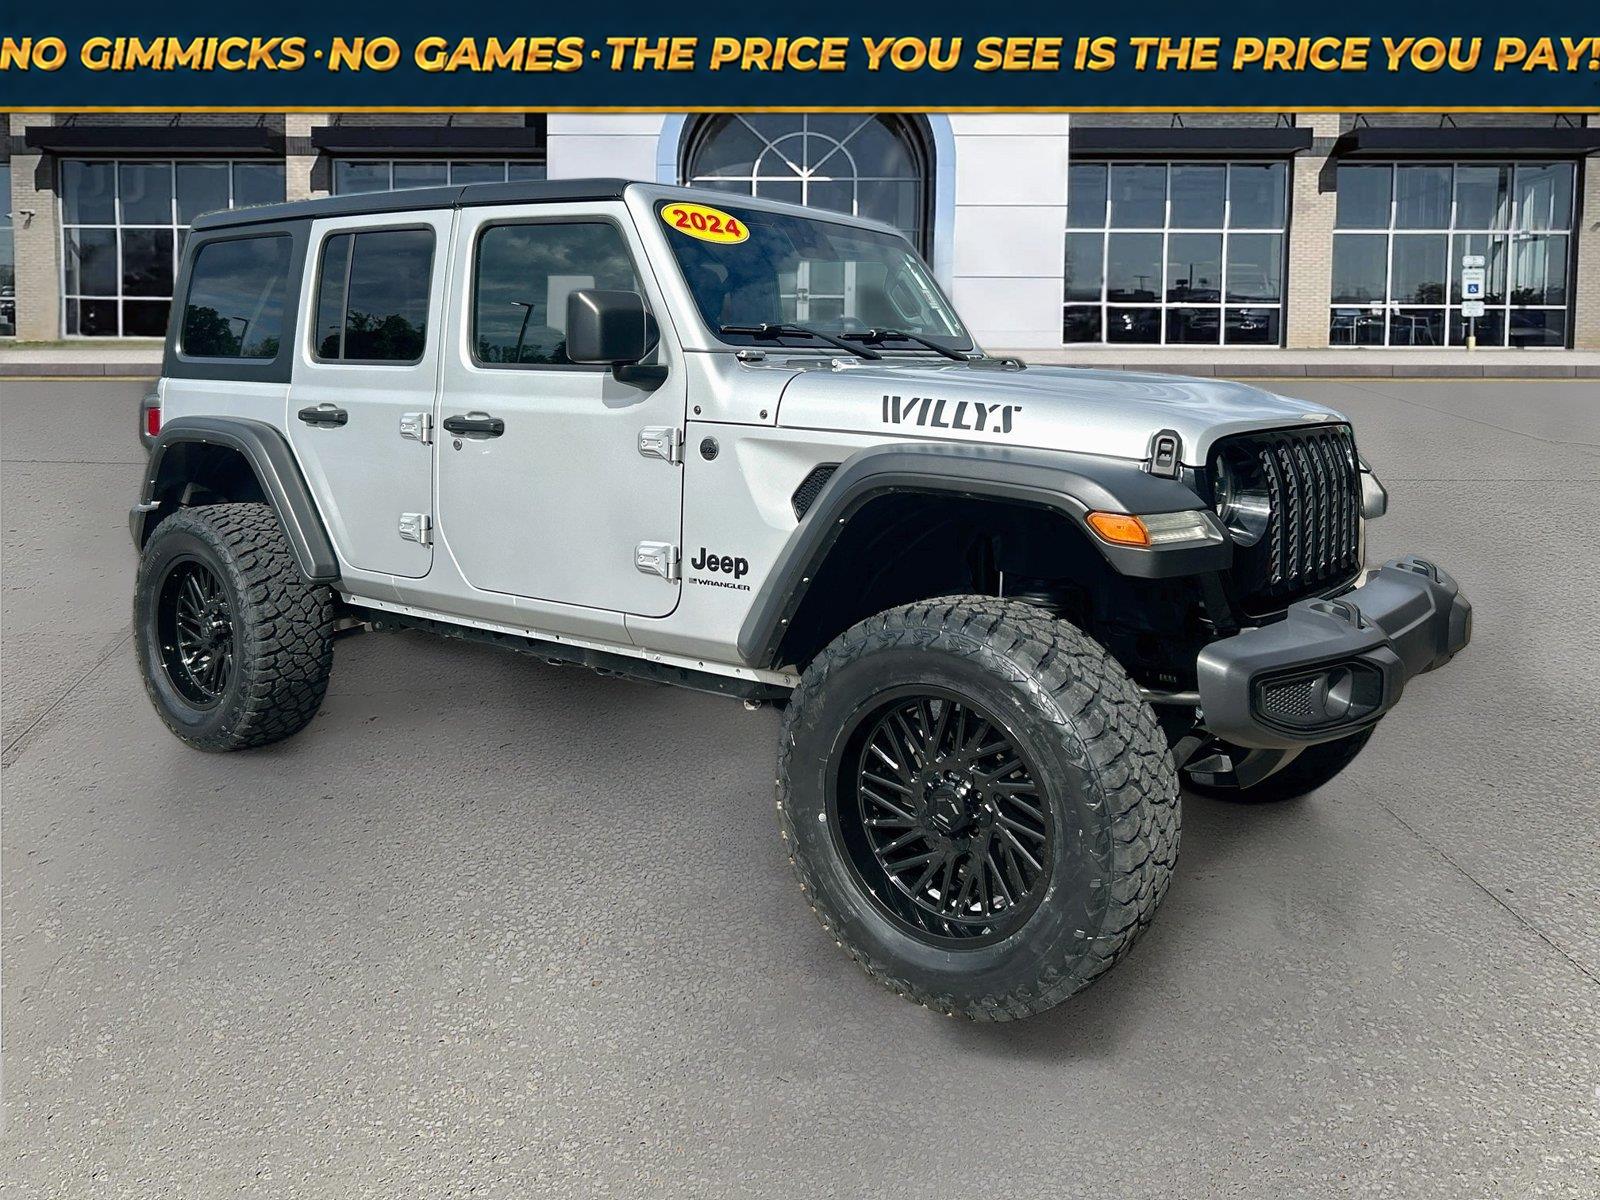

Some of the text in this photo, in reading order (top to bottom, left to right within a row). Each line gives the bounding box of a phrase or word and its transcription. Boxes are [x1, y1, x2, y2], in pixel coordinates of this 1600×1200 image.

[672, 209, 742, 238] 2024
[882, 395, 1023, 434] WILLYS
[691, 547, 749, 579] Jeep
[697, 578, 751, 591] WRANGLER
